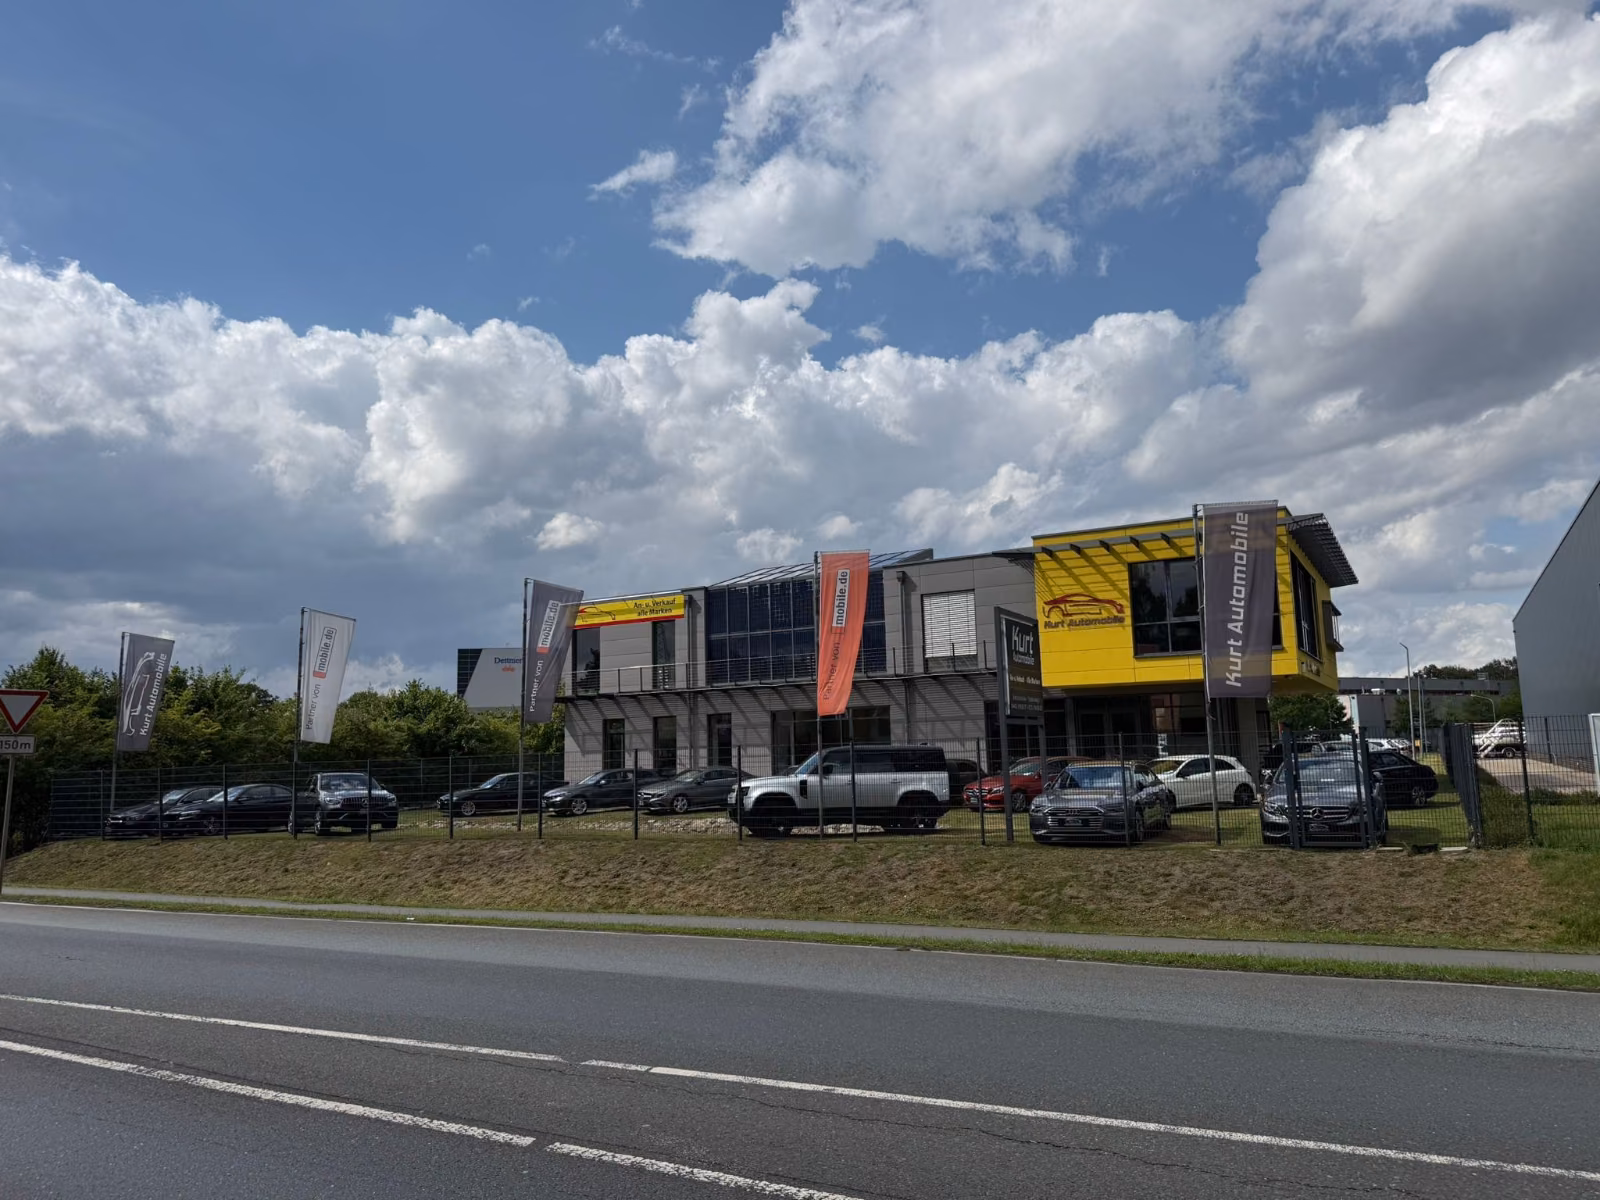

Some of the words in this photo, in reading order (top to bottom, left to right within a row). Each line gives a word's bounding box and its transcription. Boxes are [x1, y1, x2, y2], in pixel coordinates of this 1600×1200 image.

[1227, 512, 1249, 634] Automobile
[649, 607, 672, 615] Marken
[652, 598, 676, 607] Verkauf
[835, 571, 848, 625] mobile.de
[541, 601, 559, 646] mobile.de
[1012, 625, 1033, 654] Kurt
[1044, 620, 1065, 629] Kurt
[1068, 615, 1125, 627] Automobile
[318, 628, 334, 671] mobile.de
[535, 660, 543, 676] von
[823, 664, 837, 701] Partner
[832, 642, 840, 661] von
[1225, 639, 1242, 687] Kurt
[139, 712, 152, 736] Kurt
[148, 653, 167, 712] Automobile
[306, 701, 318, 730] Partner
[312, 683, 321, 698] von
[530, 677, 541, 712] Partner
